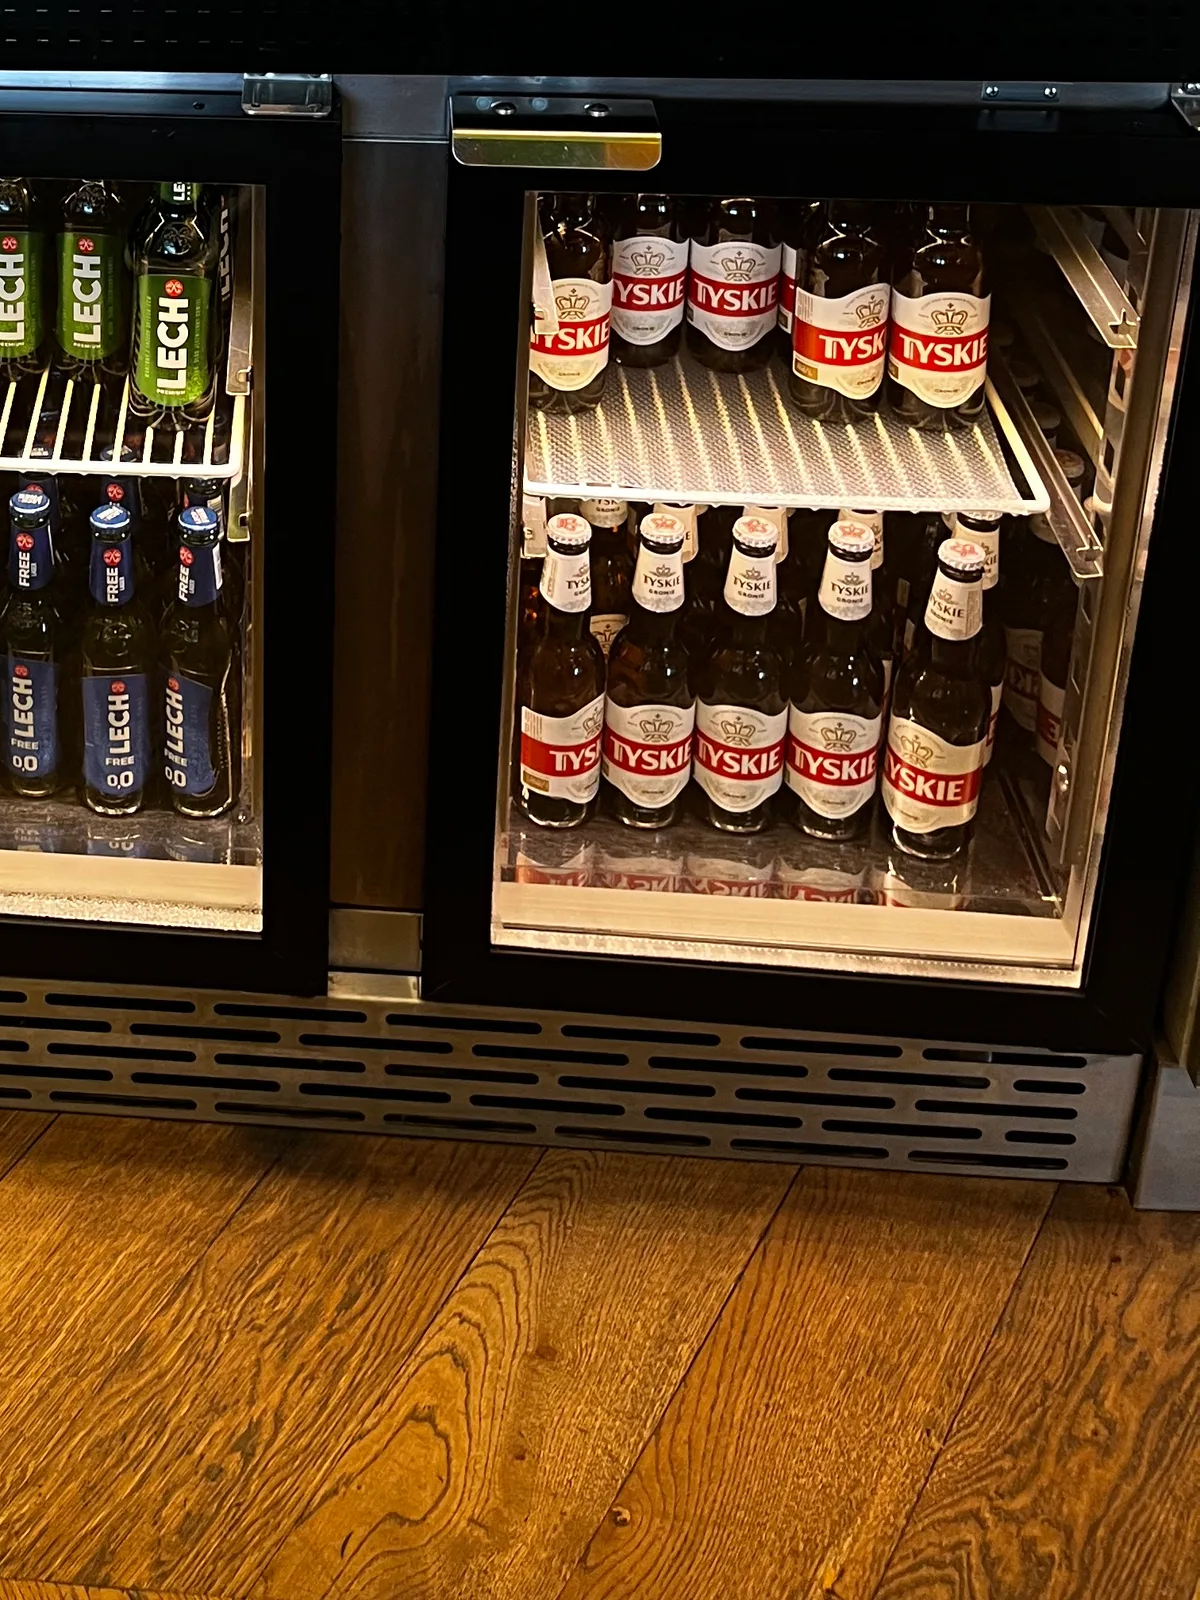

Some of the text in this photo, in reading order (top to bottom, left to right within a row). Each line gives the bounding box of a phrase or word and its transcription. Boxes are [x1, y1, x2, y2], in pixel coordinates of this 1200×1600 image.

[173, 182, 186, 201] LE
[72, 254, 102, 343] LECH
[613, 276, 685, 305] YSKIE
[694, 278, 778, 311] TYSKIE
[156, 297, 189, 389] LECH
[819, 328, 886, 360] TYSK
[899, 332, 988, 366] TYSKIE
[18, 552, 30, 587] FREE
[106, 568, 119, 603] FREE
[178, 564, 190, 602] FREE
[566, 577, 590, 590] TYSK
[643, 573, 681, 588] TYSKIE
[733, 575, 772, 591] TYSKIE
[831, 581, 869, 597] TYSKIE
[930, 593, 965, 619] YSKIE
[12, 676, 35, 738] LECH
[108, 694, 131, 754] LECH
[166, 687, 184, 754] LECH
[10, 737, 39, 750] FREE
[105, 755, 135, 766] FREE
[164, 748, 188, 767] FREE
[610, 736, 693, 770] TYSKIE
[697, 734, 781, 775] TYSKIE
[792, 740, 877, 781] TYSKIE
[887, 753, 965, 801] YSKIE
